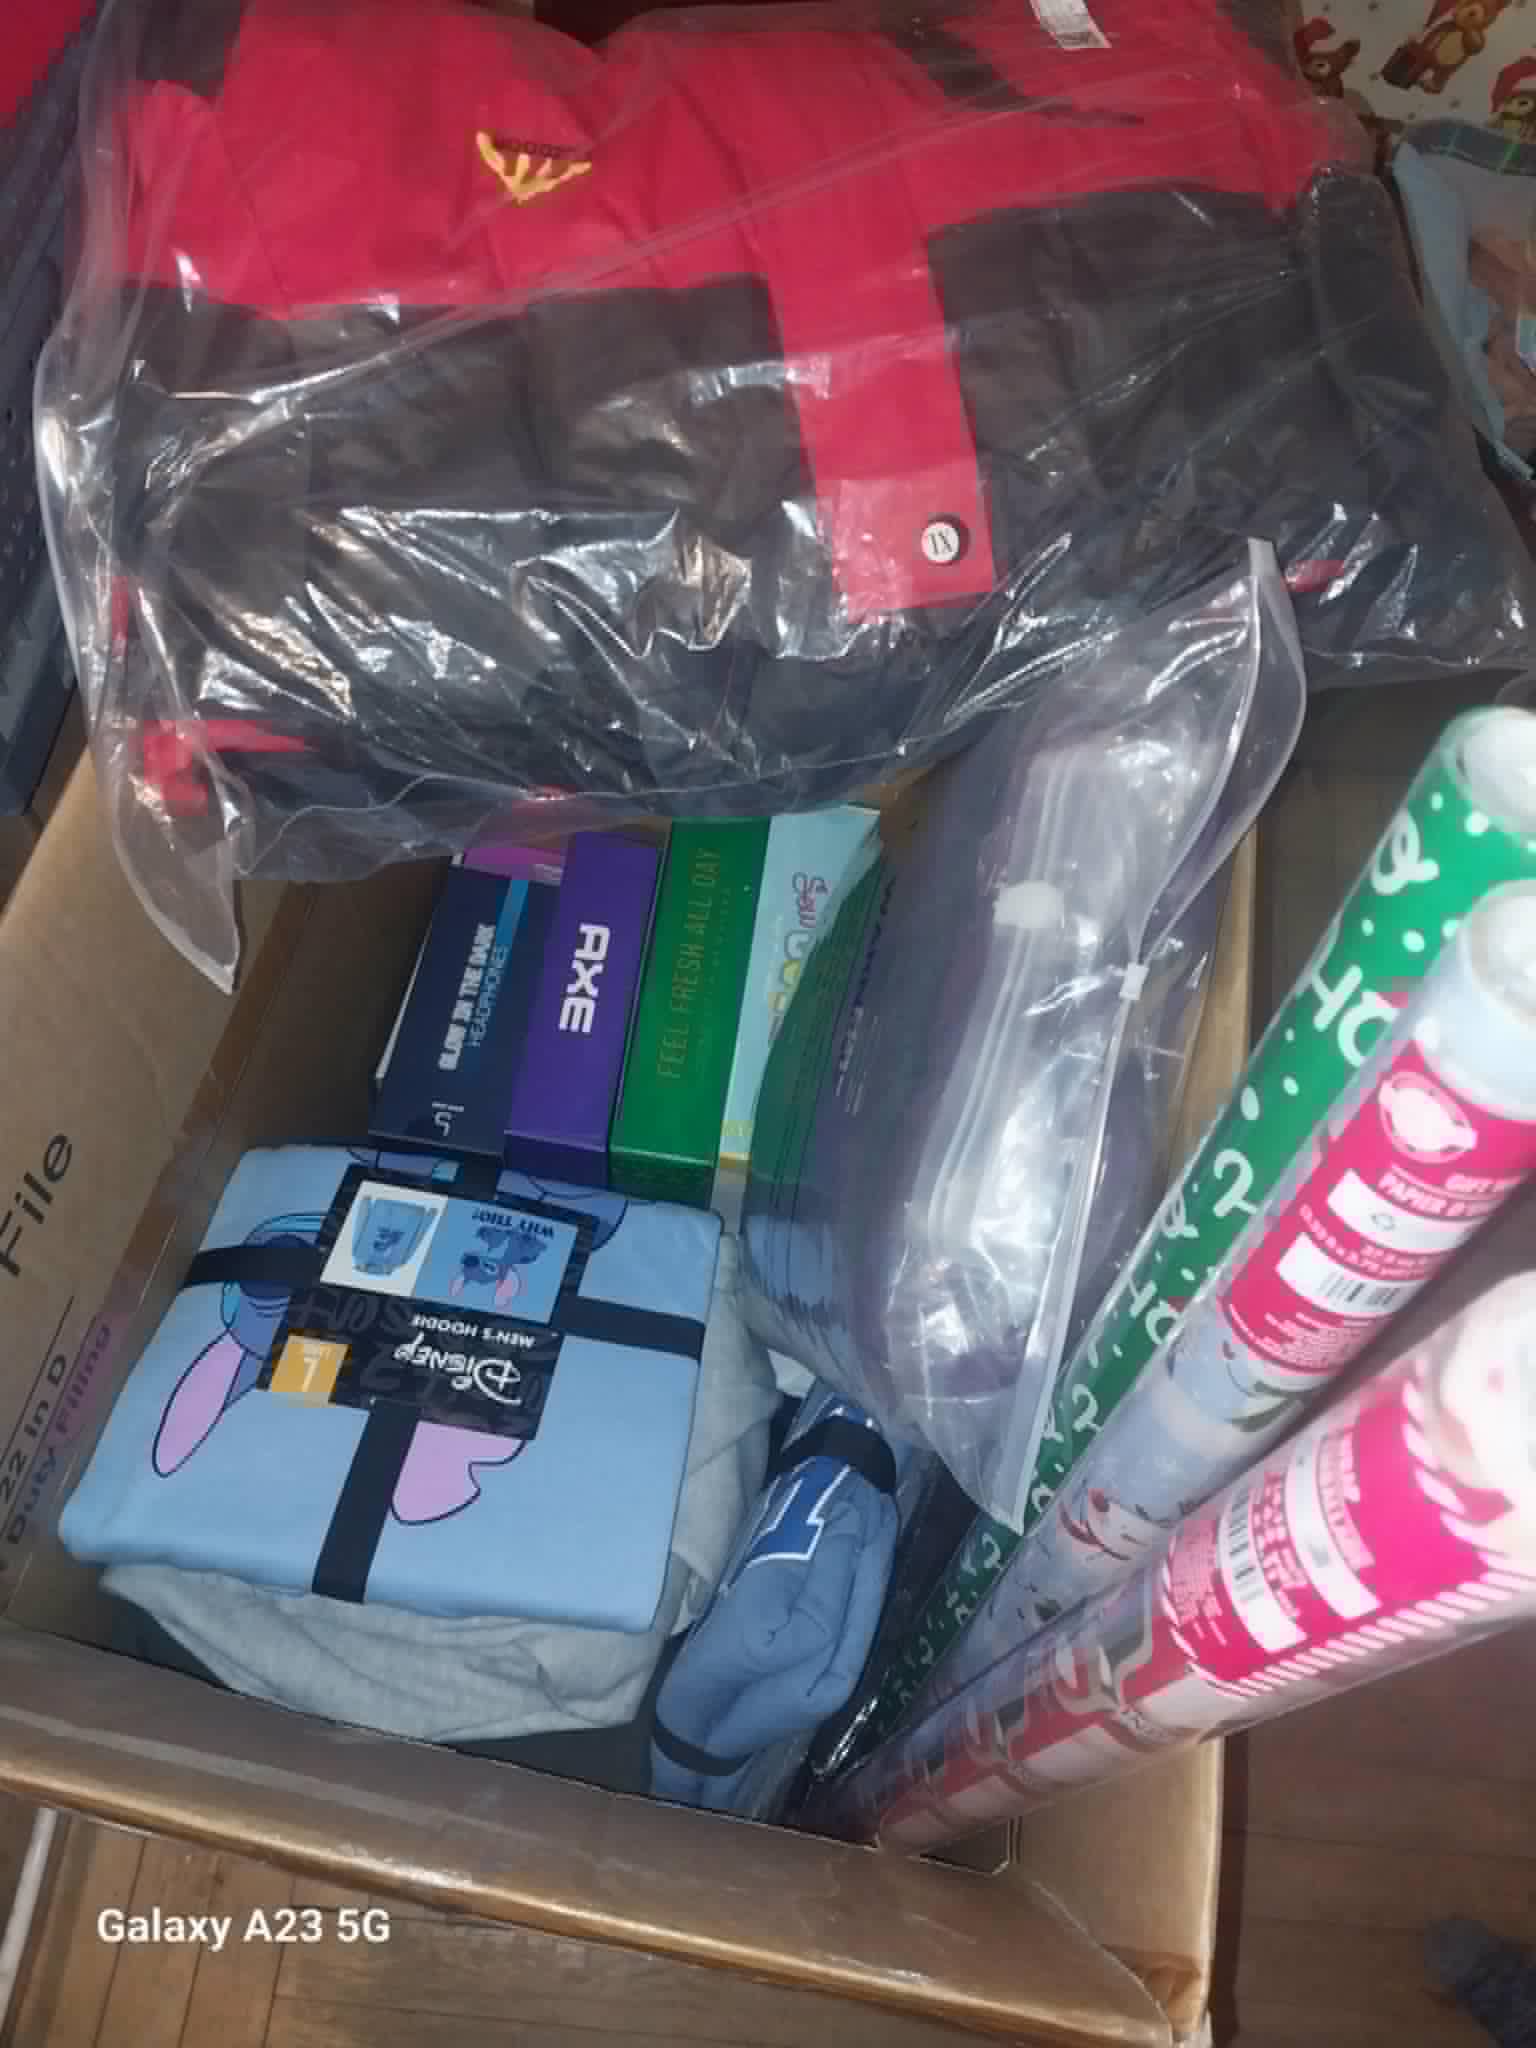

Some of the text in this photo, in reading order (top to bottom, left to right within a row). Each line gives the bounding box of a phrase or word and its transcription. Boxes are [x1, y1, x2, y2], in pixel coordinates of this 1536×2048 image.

[691, 847, 721, 888] DAY
[683, 895, 713, 937] ALL
[558, 922, 611, 1033] AXE
[671, 943, 706, 1016] FRESH
[656, 1022, 690, 1079] FEEL
[0, 1132, 72, 1276] File
